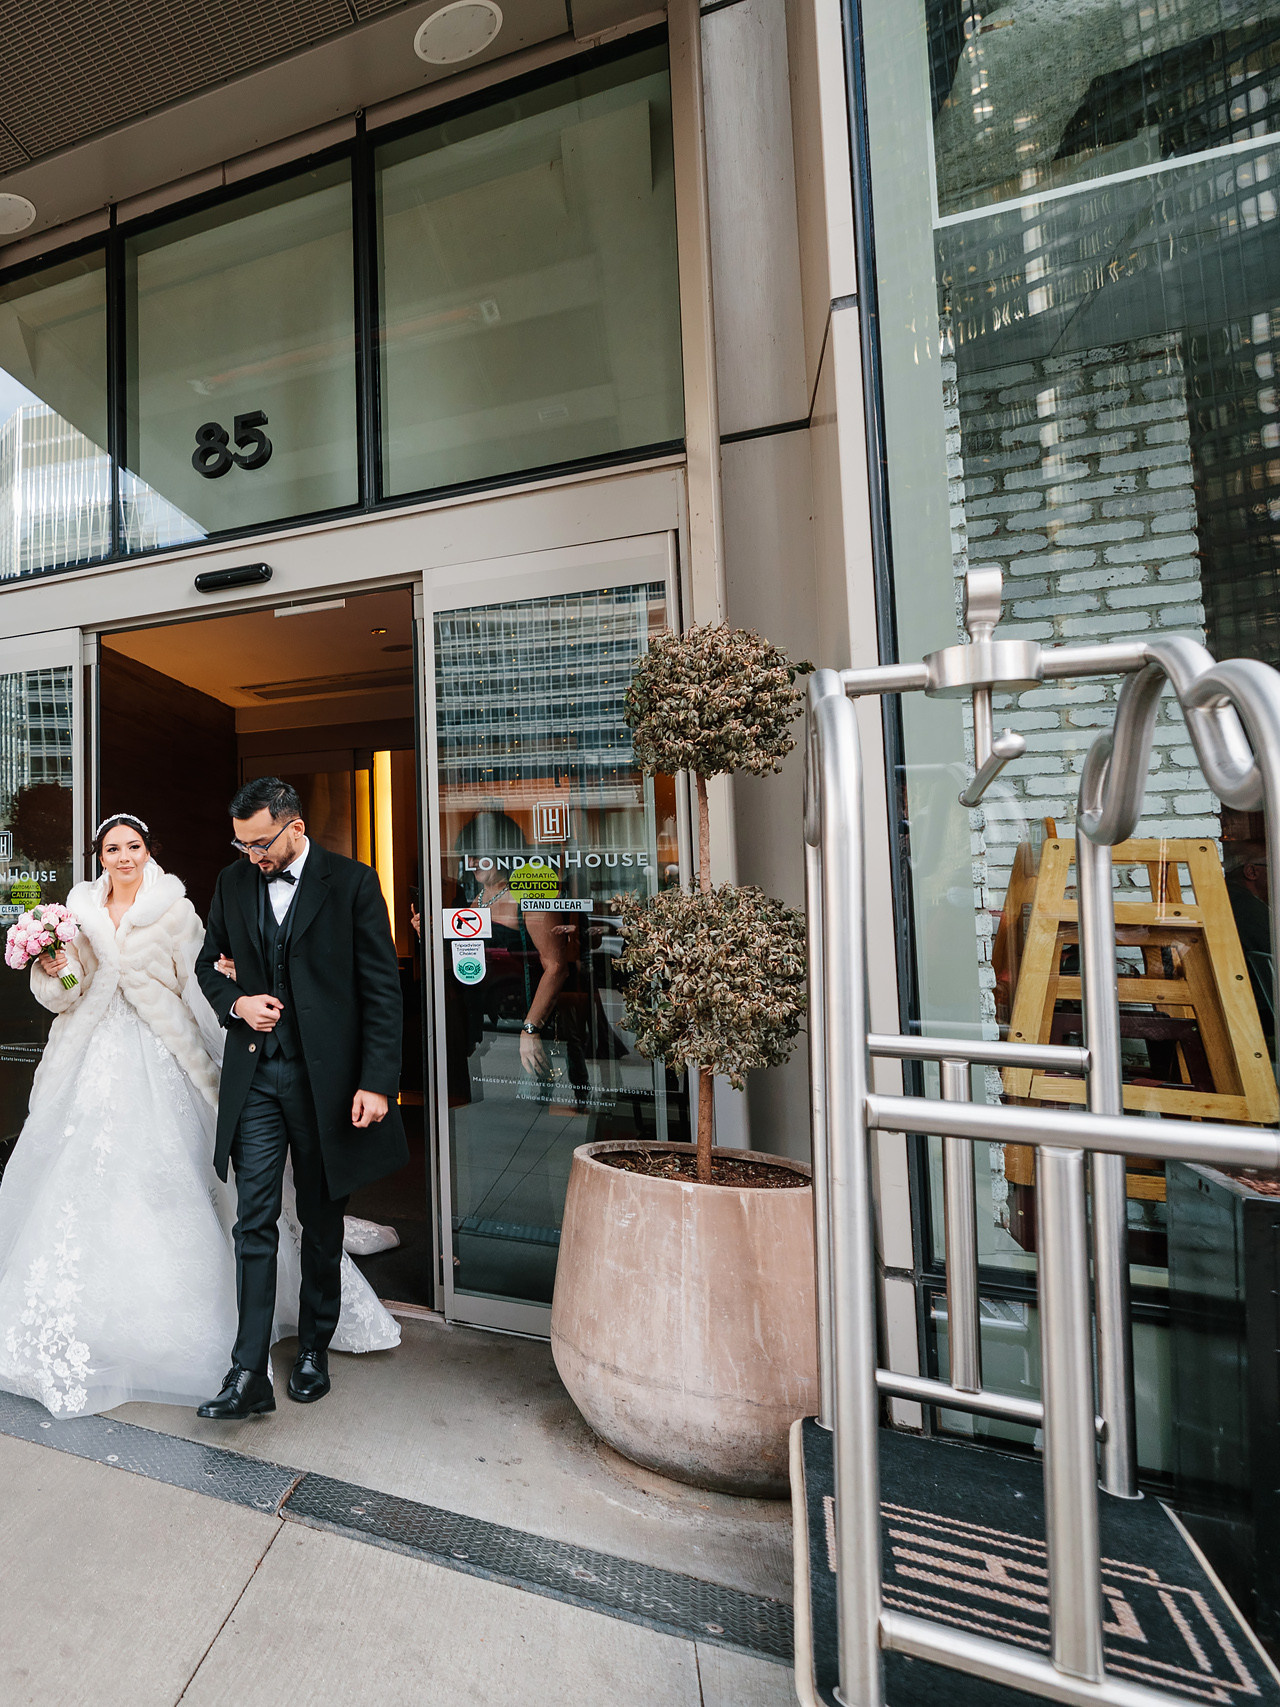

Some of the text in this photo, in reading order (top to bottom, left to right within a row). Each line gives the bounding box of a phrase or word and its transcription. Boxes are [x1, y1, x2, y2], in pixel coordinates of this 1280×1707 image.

[192, 410, 273, 479] 85
[464, 850, 649, 872] LONDONHOUSE
[510, 881, 557, 890] CAUTION
[523, 901, 551, 910] STAND
[553, 901, 582, 910] CLEAR
